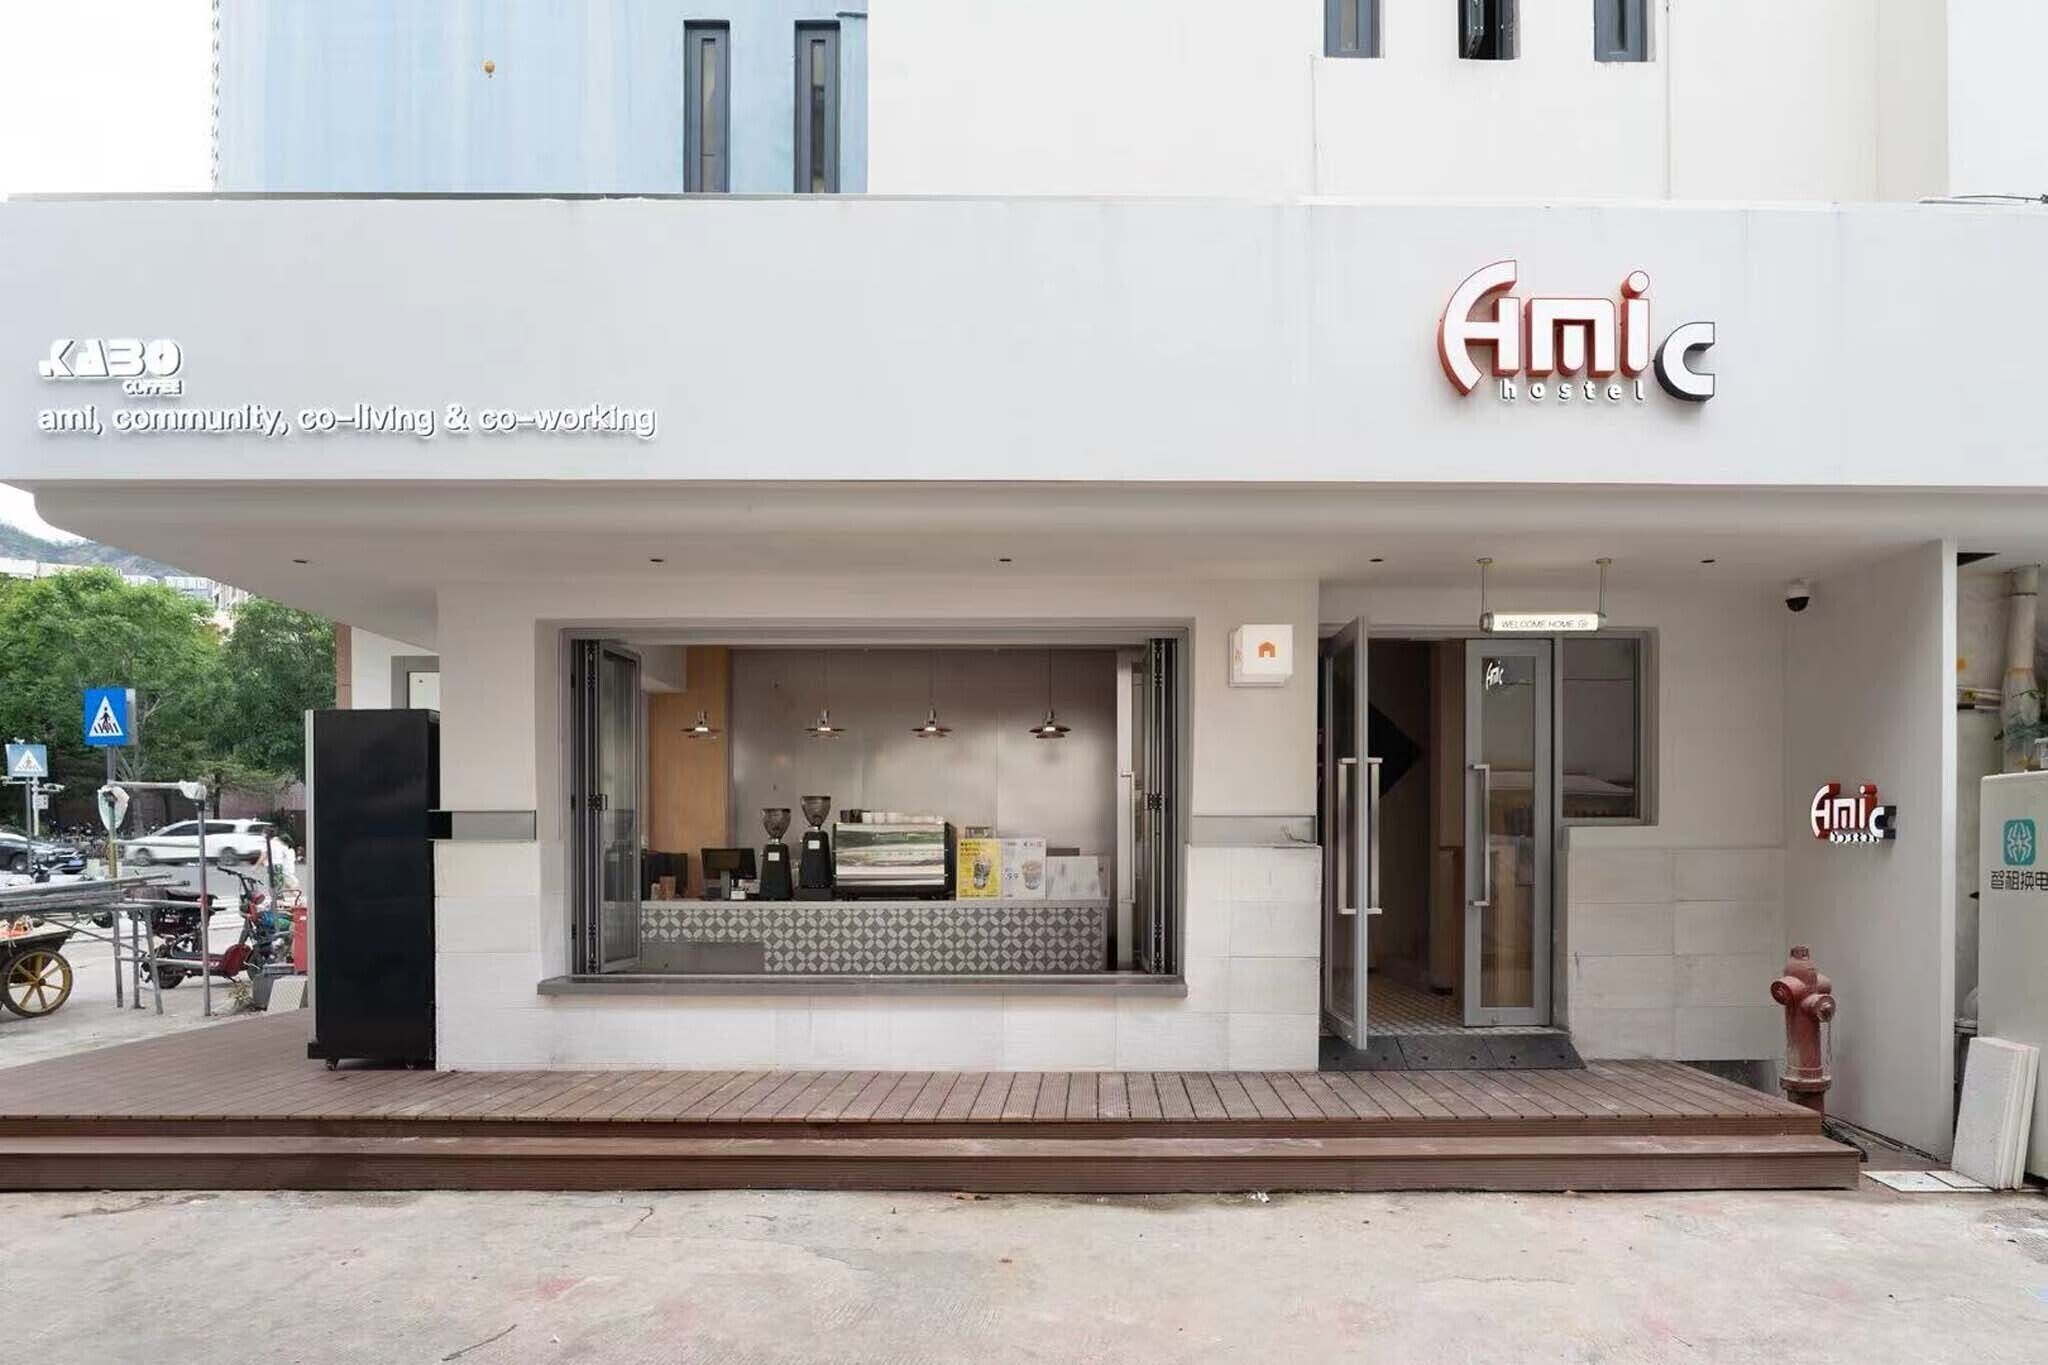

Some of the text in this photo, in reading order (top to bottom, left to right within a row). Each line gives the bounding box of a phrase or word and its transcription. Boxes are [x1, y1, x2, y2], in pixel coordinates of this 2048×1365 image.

[38, 338, 183, 378] KABO
[1500, 378, 1645, 401] hostel
[38, 402, 658, 439] ami, community, co-living & co-working
[1500, 619, 1545, 630] WELCOME
[1548, 619, 1574, 630] HOME
